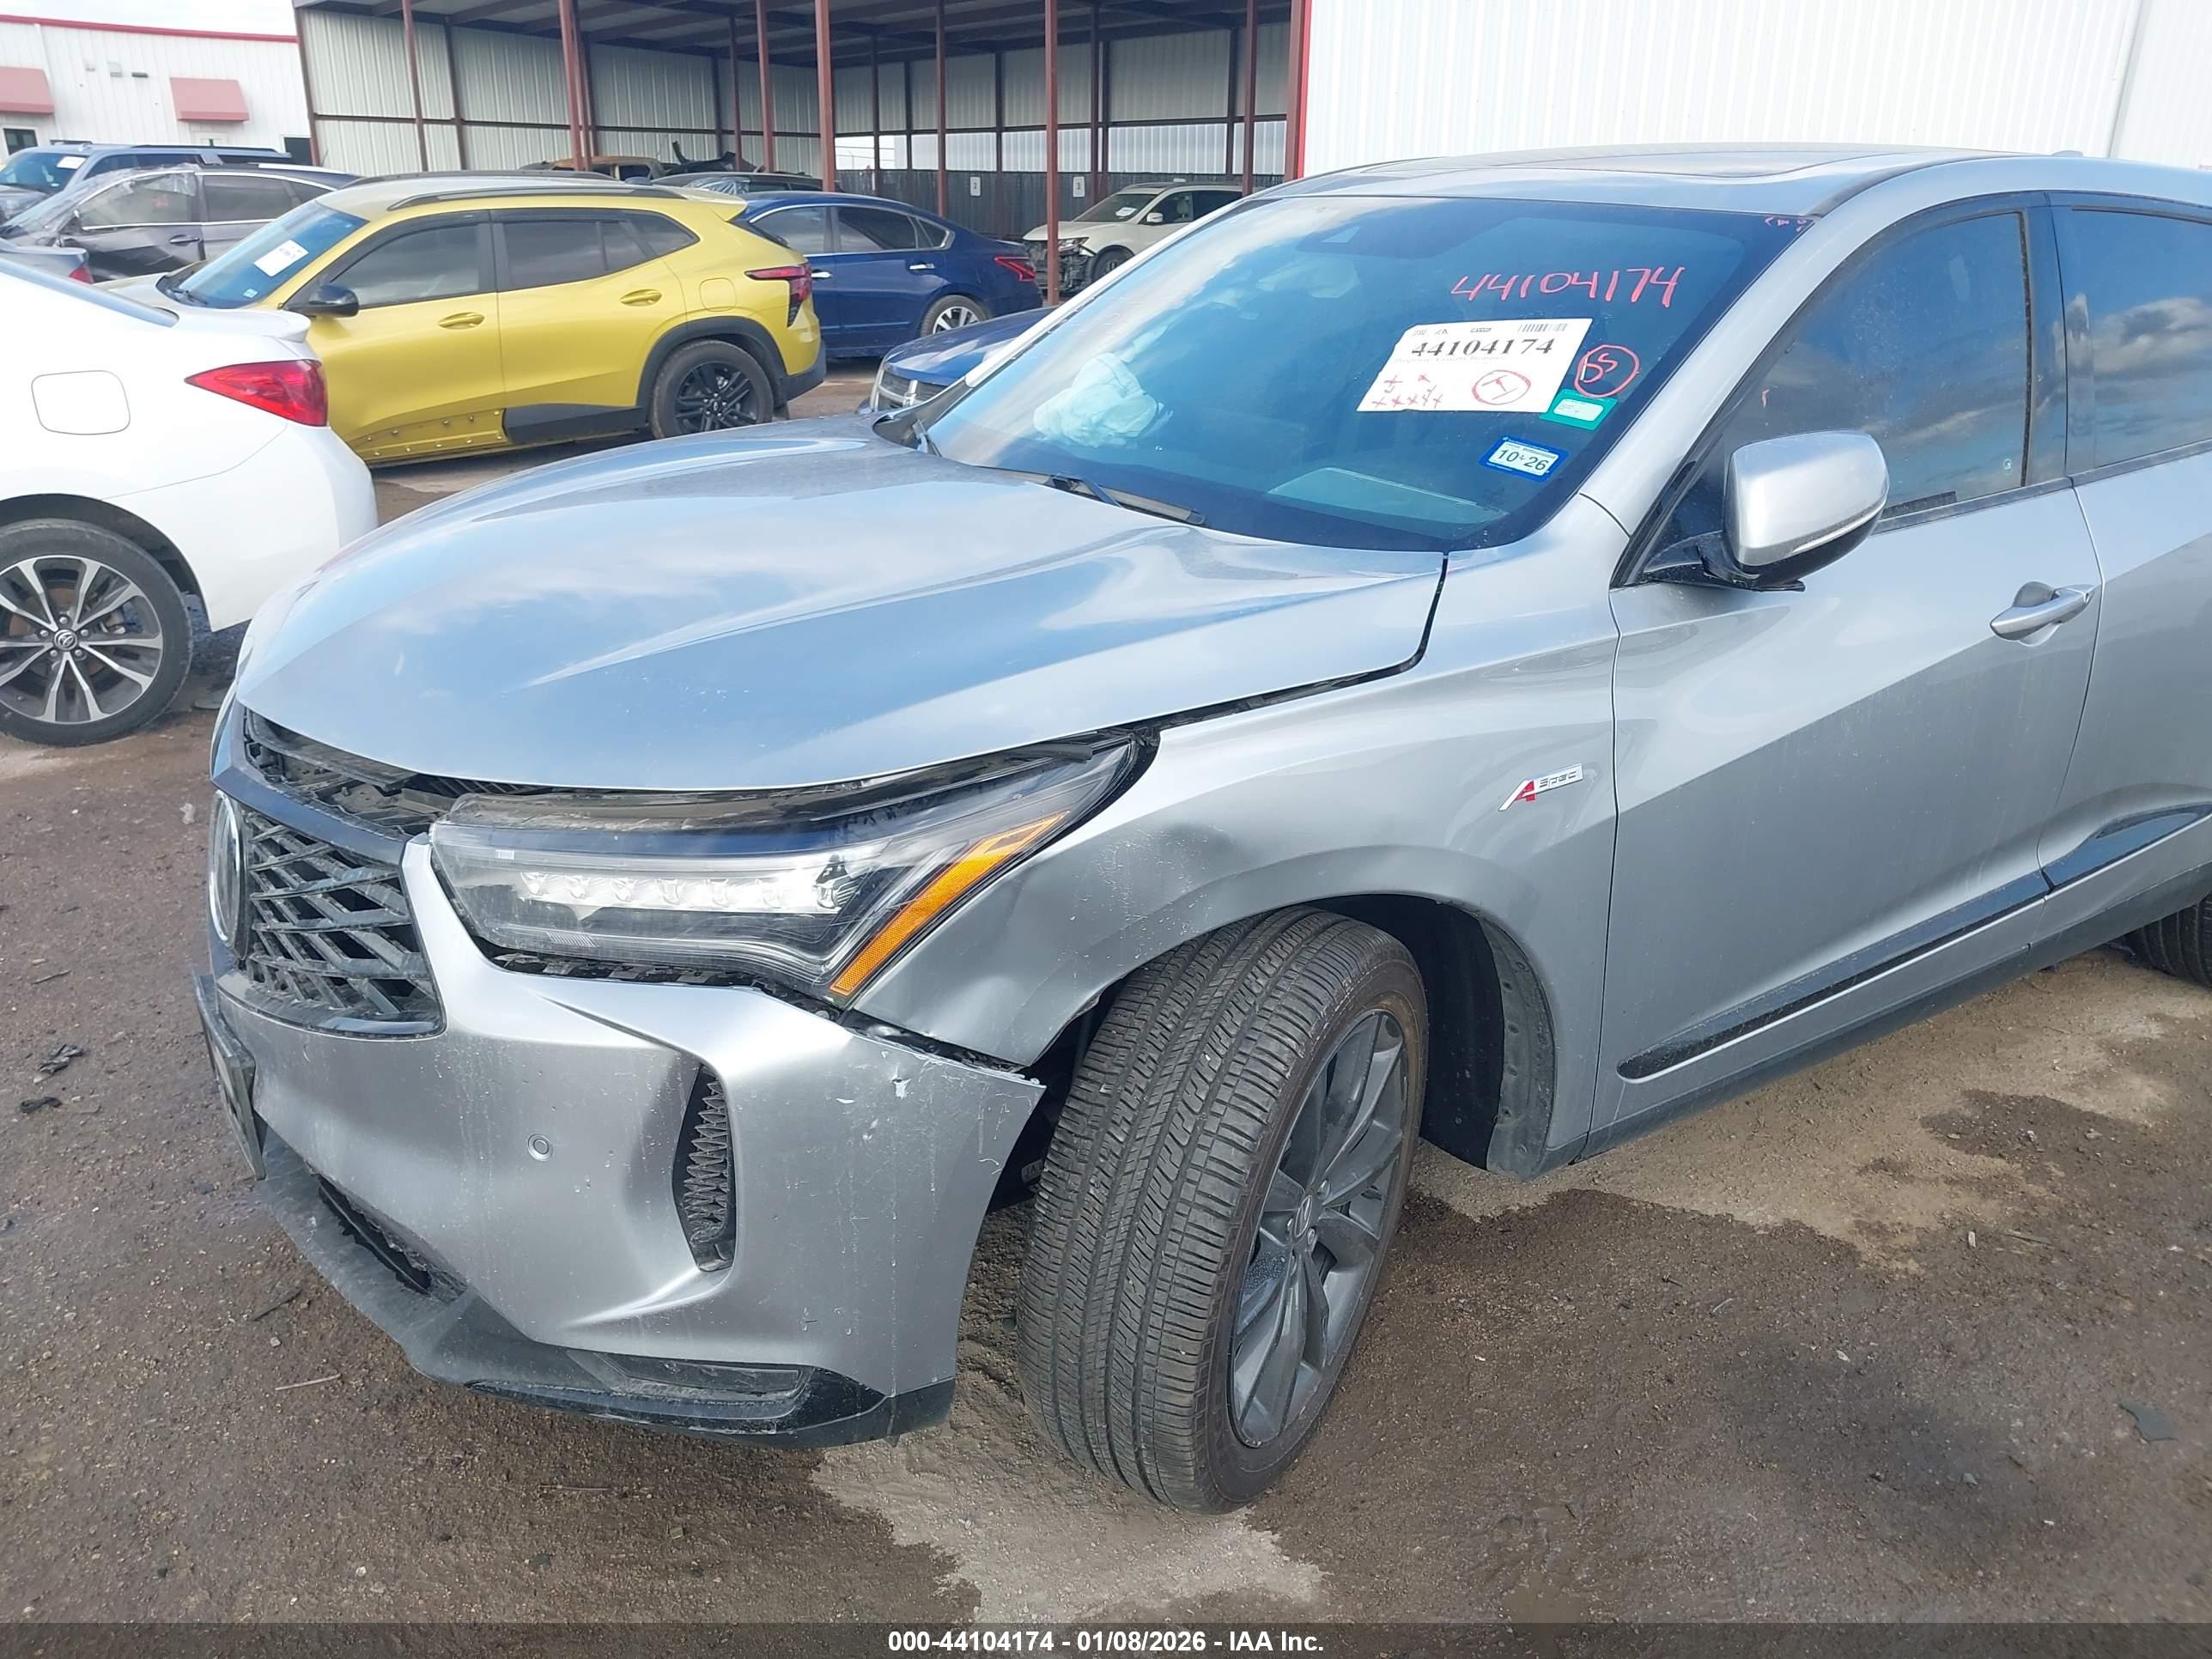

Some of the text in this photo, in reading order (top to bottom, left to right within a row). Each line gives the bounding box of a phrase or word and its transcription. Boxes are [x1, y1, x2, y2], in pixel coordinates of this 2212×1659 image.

[1450, 266, 1686, 308] 44104174
[1411, 338, 1555, 356] 44104174
[1498, 450, 1519, 462] 10
[1523, 457, 1549, 471] 26
